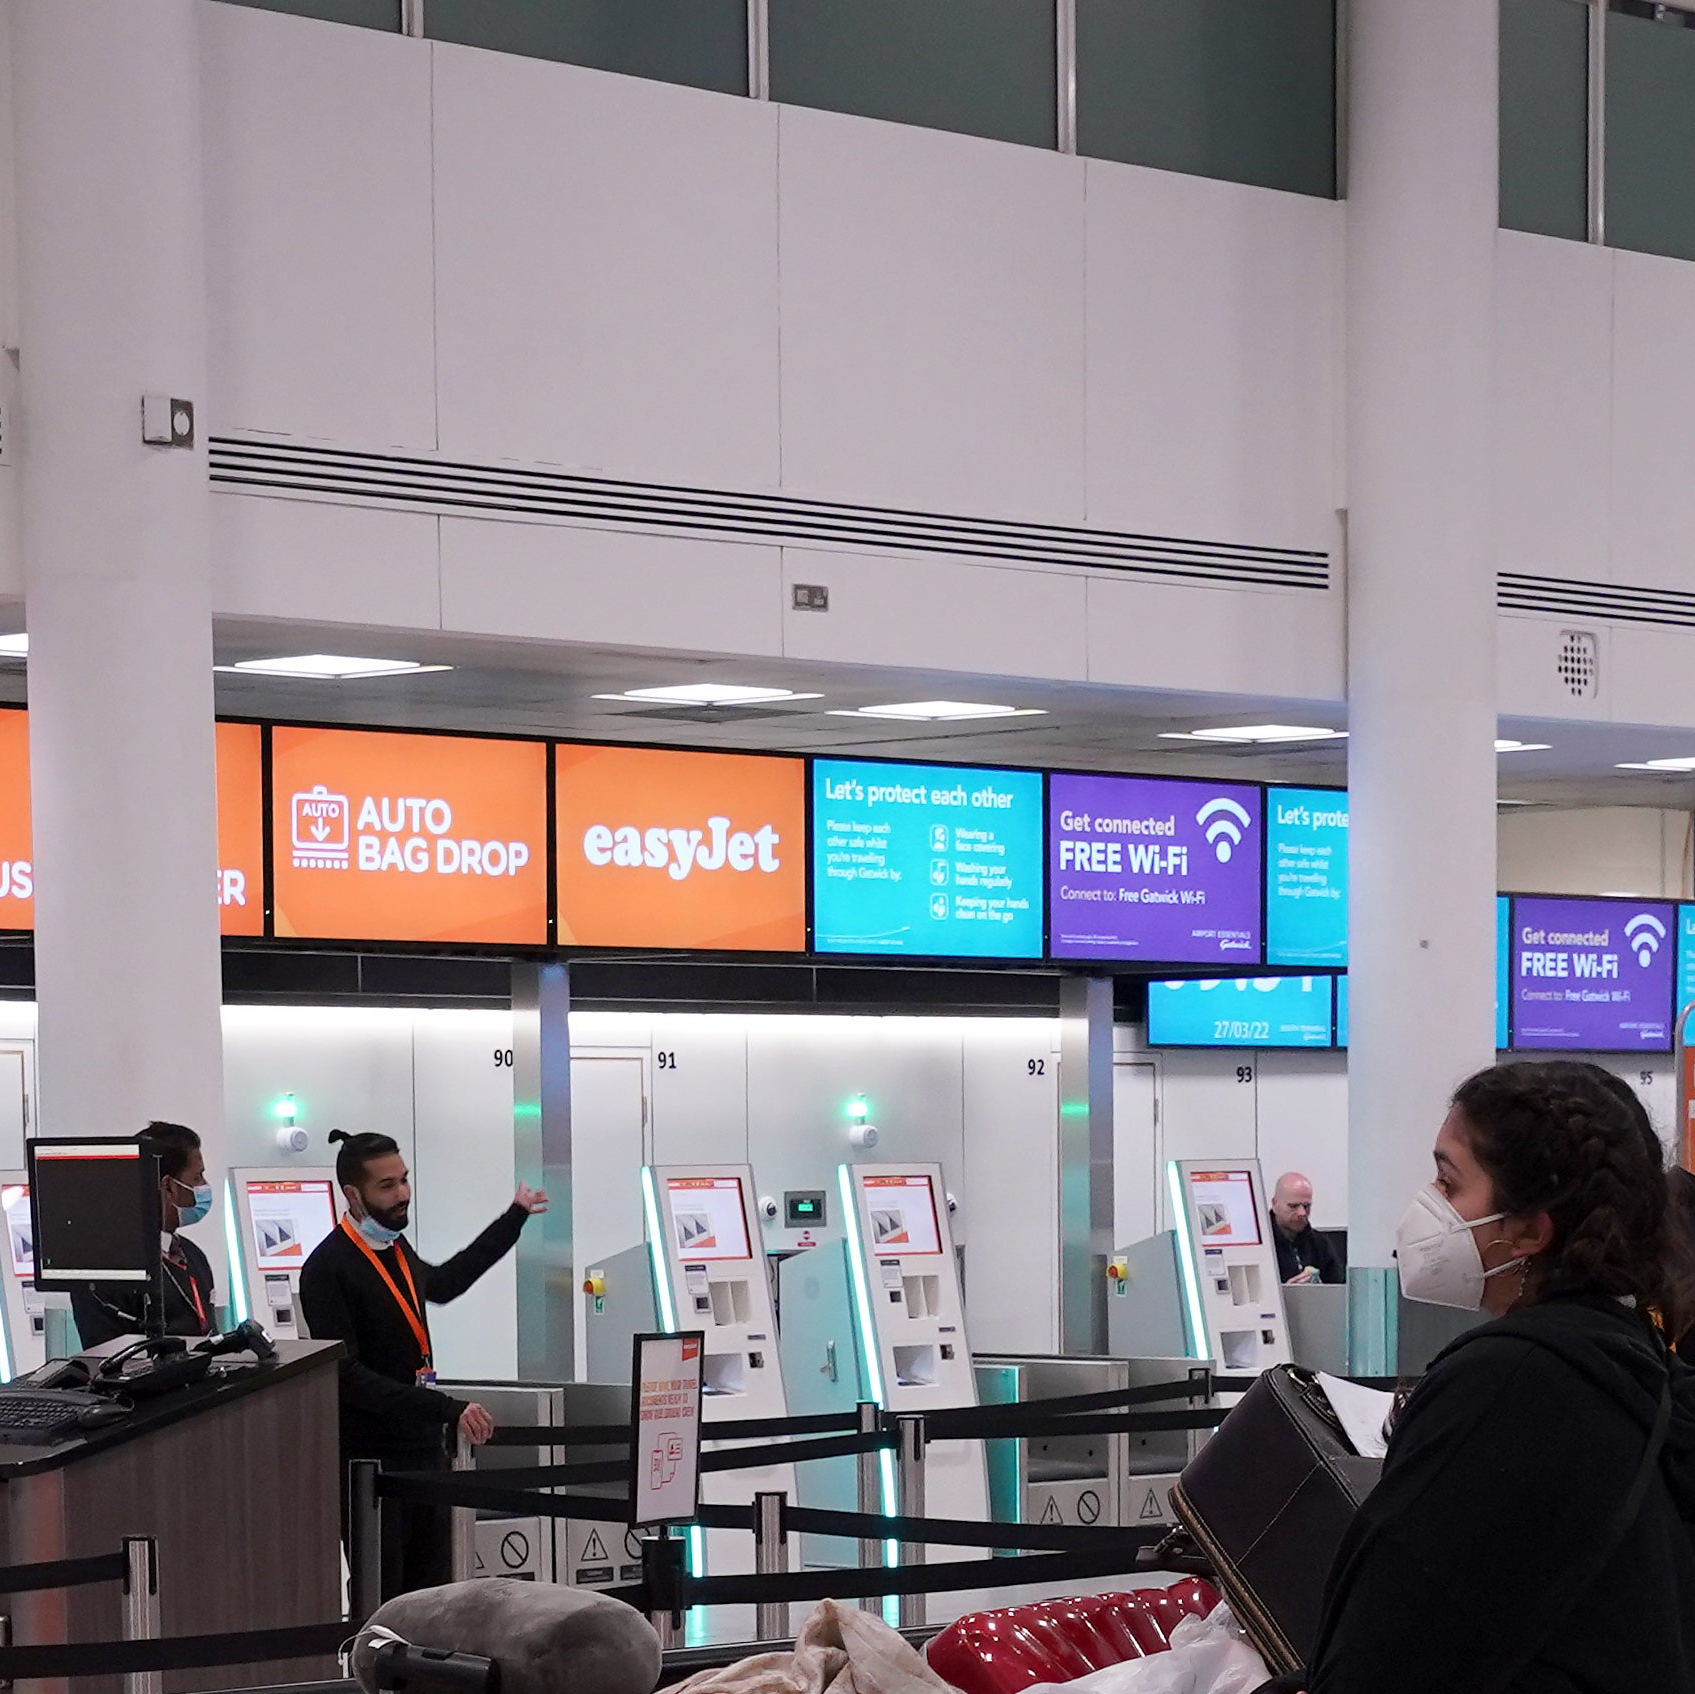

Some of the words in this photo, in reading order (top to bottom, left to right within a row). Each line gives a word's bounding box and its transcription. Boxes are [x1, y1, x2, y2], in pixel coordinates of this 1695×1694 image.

[825, 777, 864, 800] Let's
[868, 784, 927, 807] protect
[931, 784, 967, 806] each
[971, 786, 1014, 809] other
[301, 802, 340, 818] AUTO
[356, 796, 453, 835] AUTO
[1277, 804, 1310, 826] Let's
[826, 819, 850, 832] Please
[852, 821, 871, 835] keep
[1060, 810, 1091, 832] Get
[1094, 814, 1175, 836] connected
[358, 835, 430, 873] BAG
[436, 838, 530, 877] DROP
[583, 816, 781, 881] easyJet
[1059, 840, 1122, 873] FREE
[1127, 843, 1188, 876] Wi-Fi
[955, 862, 986, 876] Washing
[955, 895, 987, 910] Keeping
[988, 898, 1004, 910] your
[1006, 898, 1029, 909] hands
[1060, 885, 1102, 902] Connect
[1103, 888, 1117, 902] to:
[1118, 887, 1139, 903] Free
[1140, 888, 1179, 904] Gatwick
[1180, 890, 1206, 905] Wi-Fi
[955, 908, 975, 920] clean
[976, 911, 987, 920] on
[989, 910, 1001, 921] the
[1002, 912, 1014, 923] go
[1521, 926, 1546, 945] Get
[1547, 928, 1609, 947] connected
[1520, 951, 1569, 977] FREE
[1572, 952, 1619, 979] Wi-Fi
[1213, 1020, 1269, 1039] 27/03/22
[494, 1049, 514, 1068] 90
[658, 1051, 677, 1070] 91
[1027, 1059, 1046, 1076] 92
[1236, 1066, 1253, 1083] 93
[1639, 1071, 1654, 1086] 95
